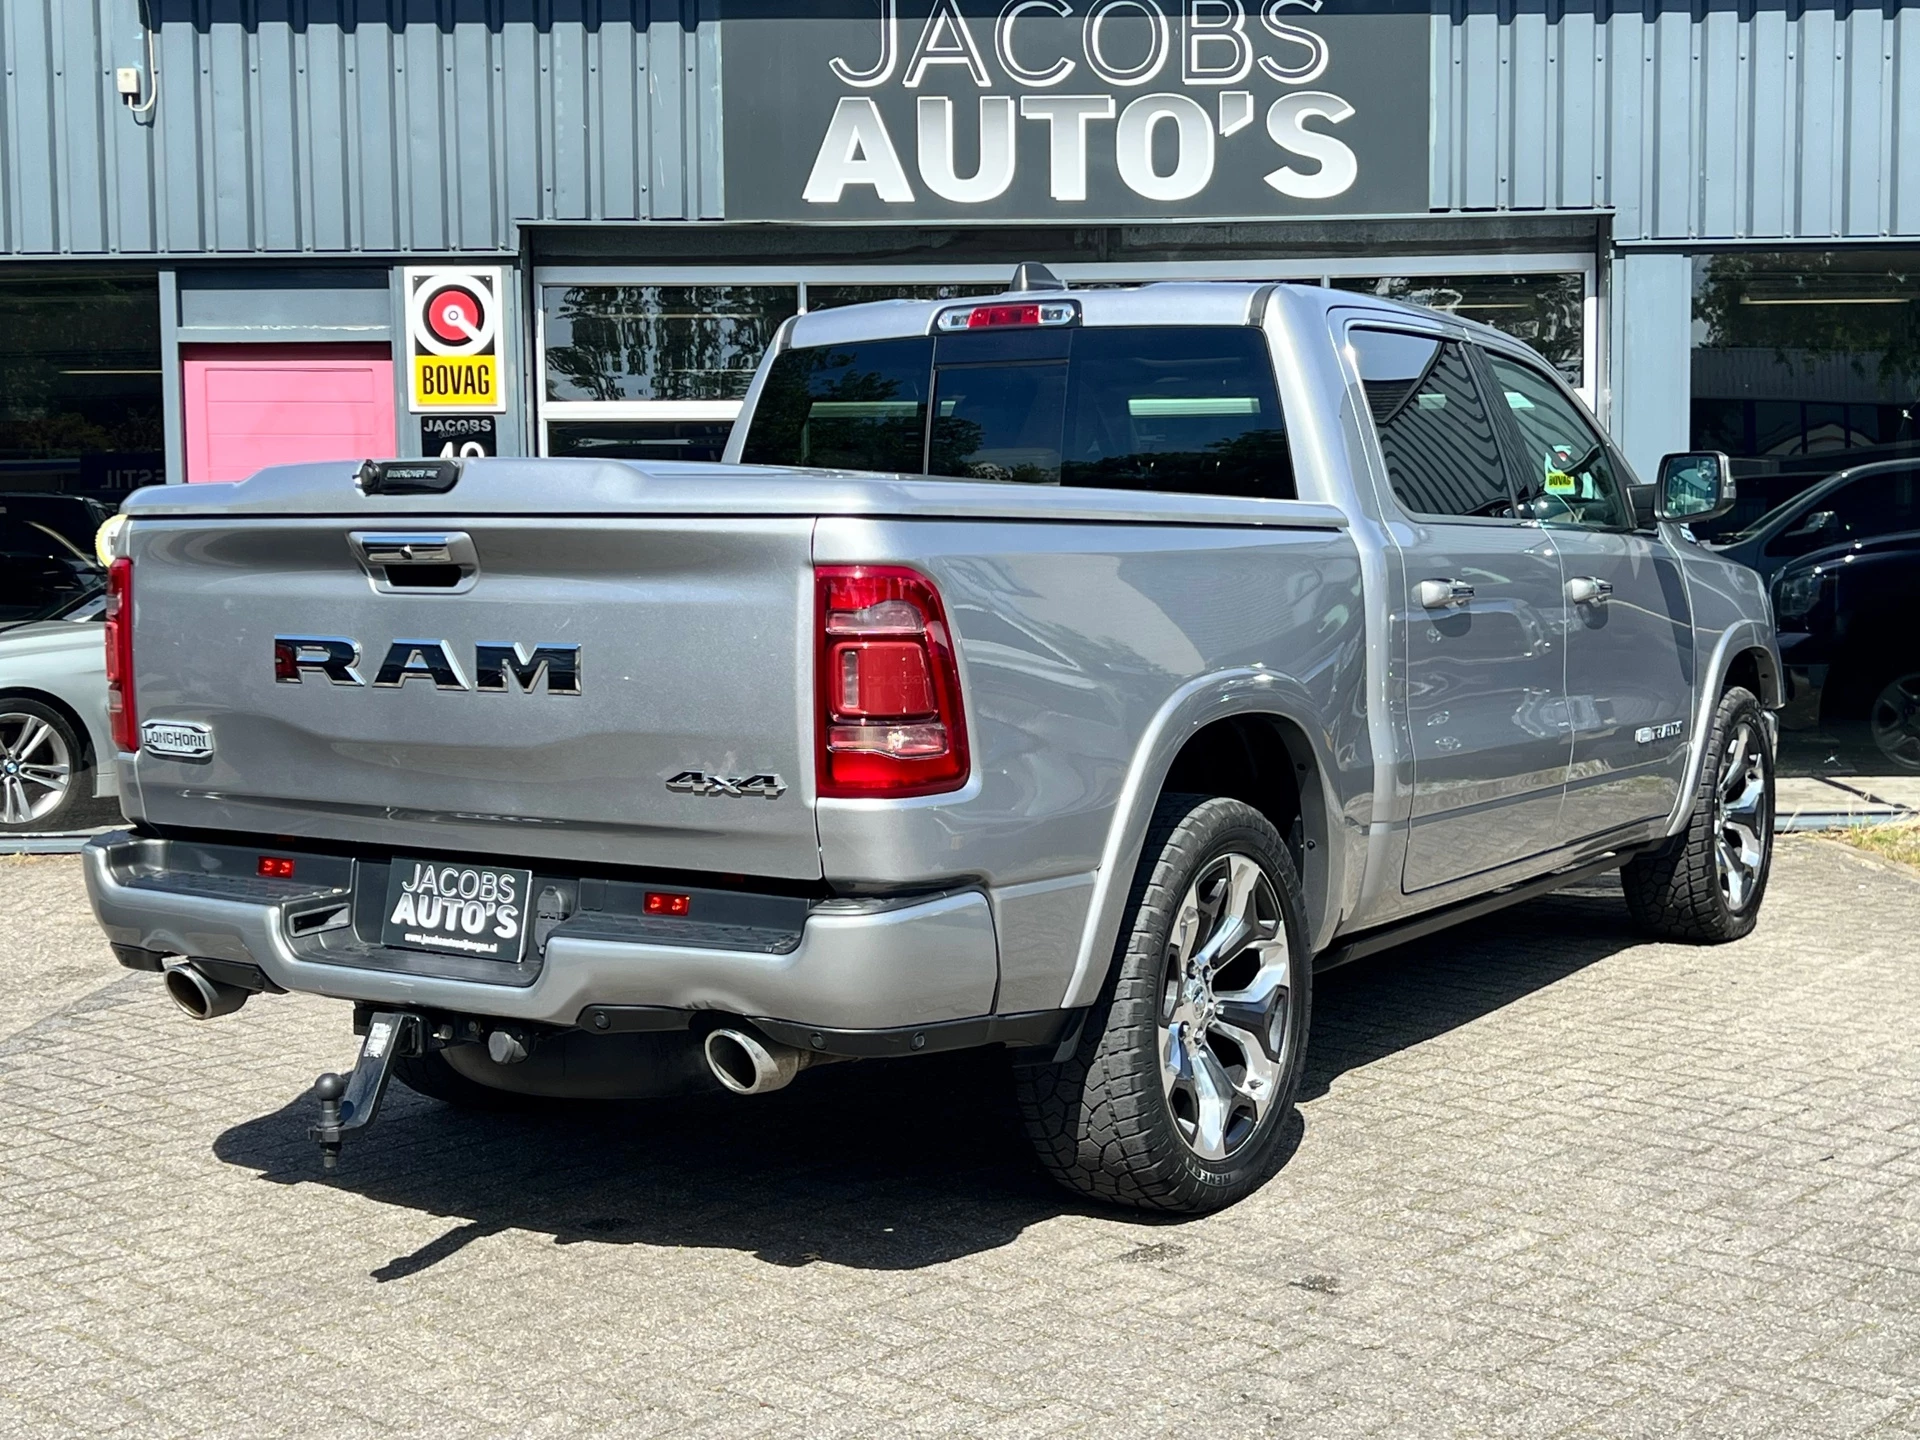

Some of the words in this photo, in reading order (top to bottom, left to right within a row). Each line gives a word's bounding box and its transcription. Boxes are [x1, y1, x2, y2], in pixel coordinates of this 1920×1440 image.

[829, 0, 1330, 88] JACOBS
[803, 91, 1358, 202] AUTO'S
[422, 364, 490, 395] BOVAG
[423, 420, 492, 432] JACOBS
[275, 634, 582, 696] RAM
[144, 730, 206, 748] LONGHORN
[402, 863, 515, 904] JACOBS
[391, 892, 513, 939] AUTO'S
